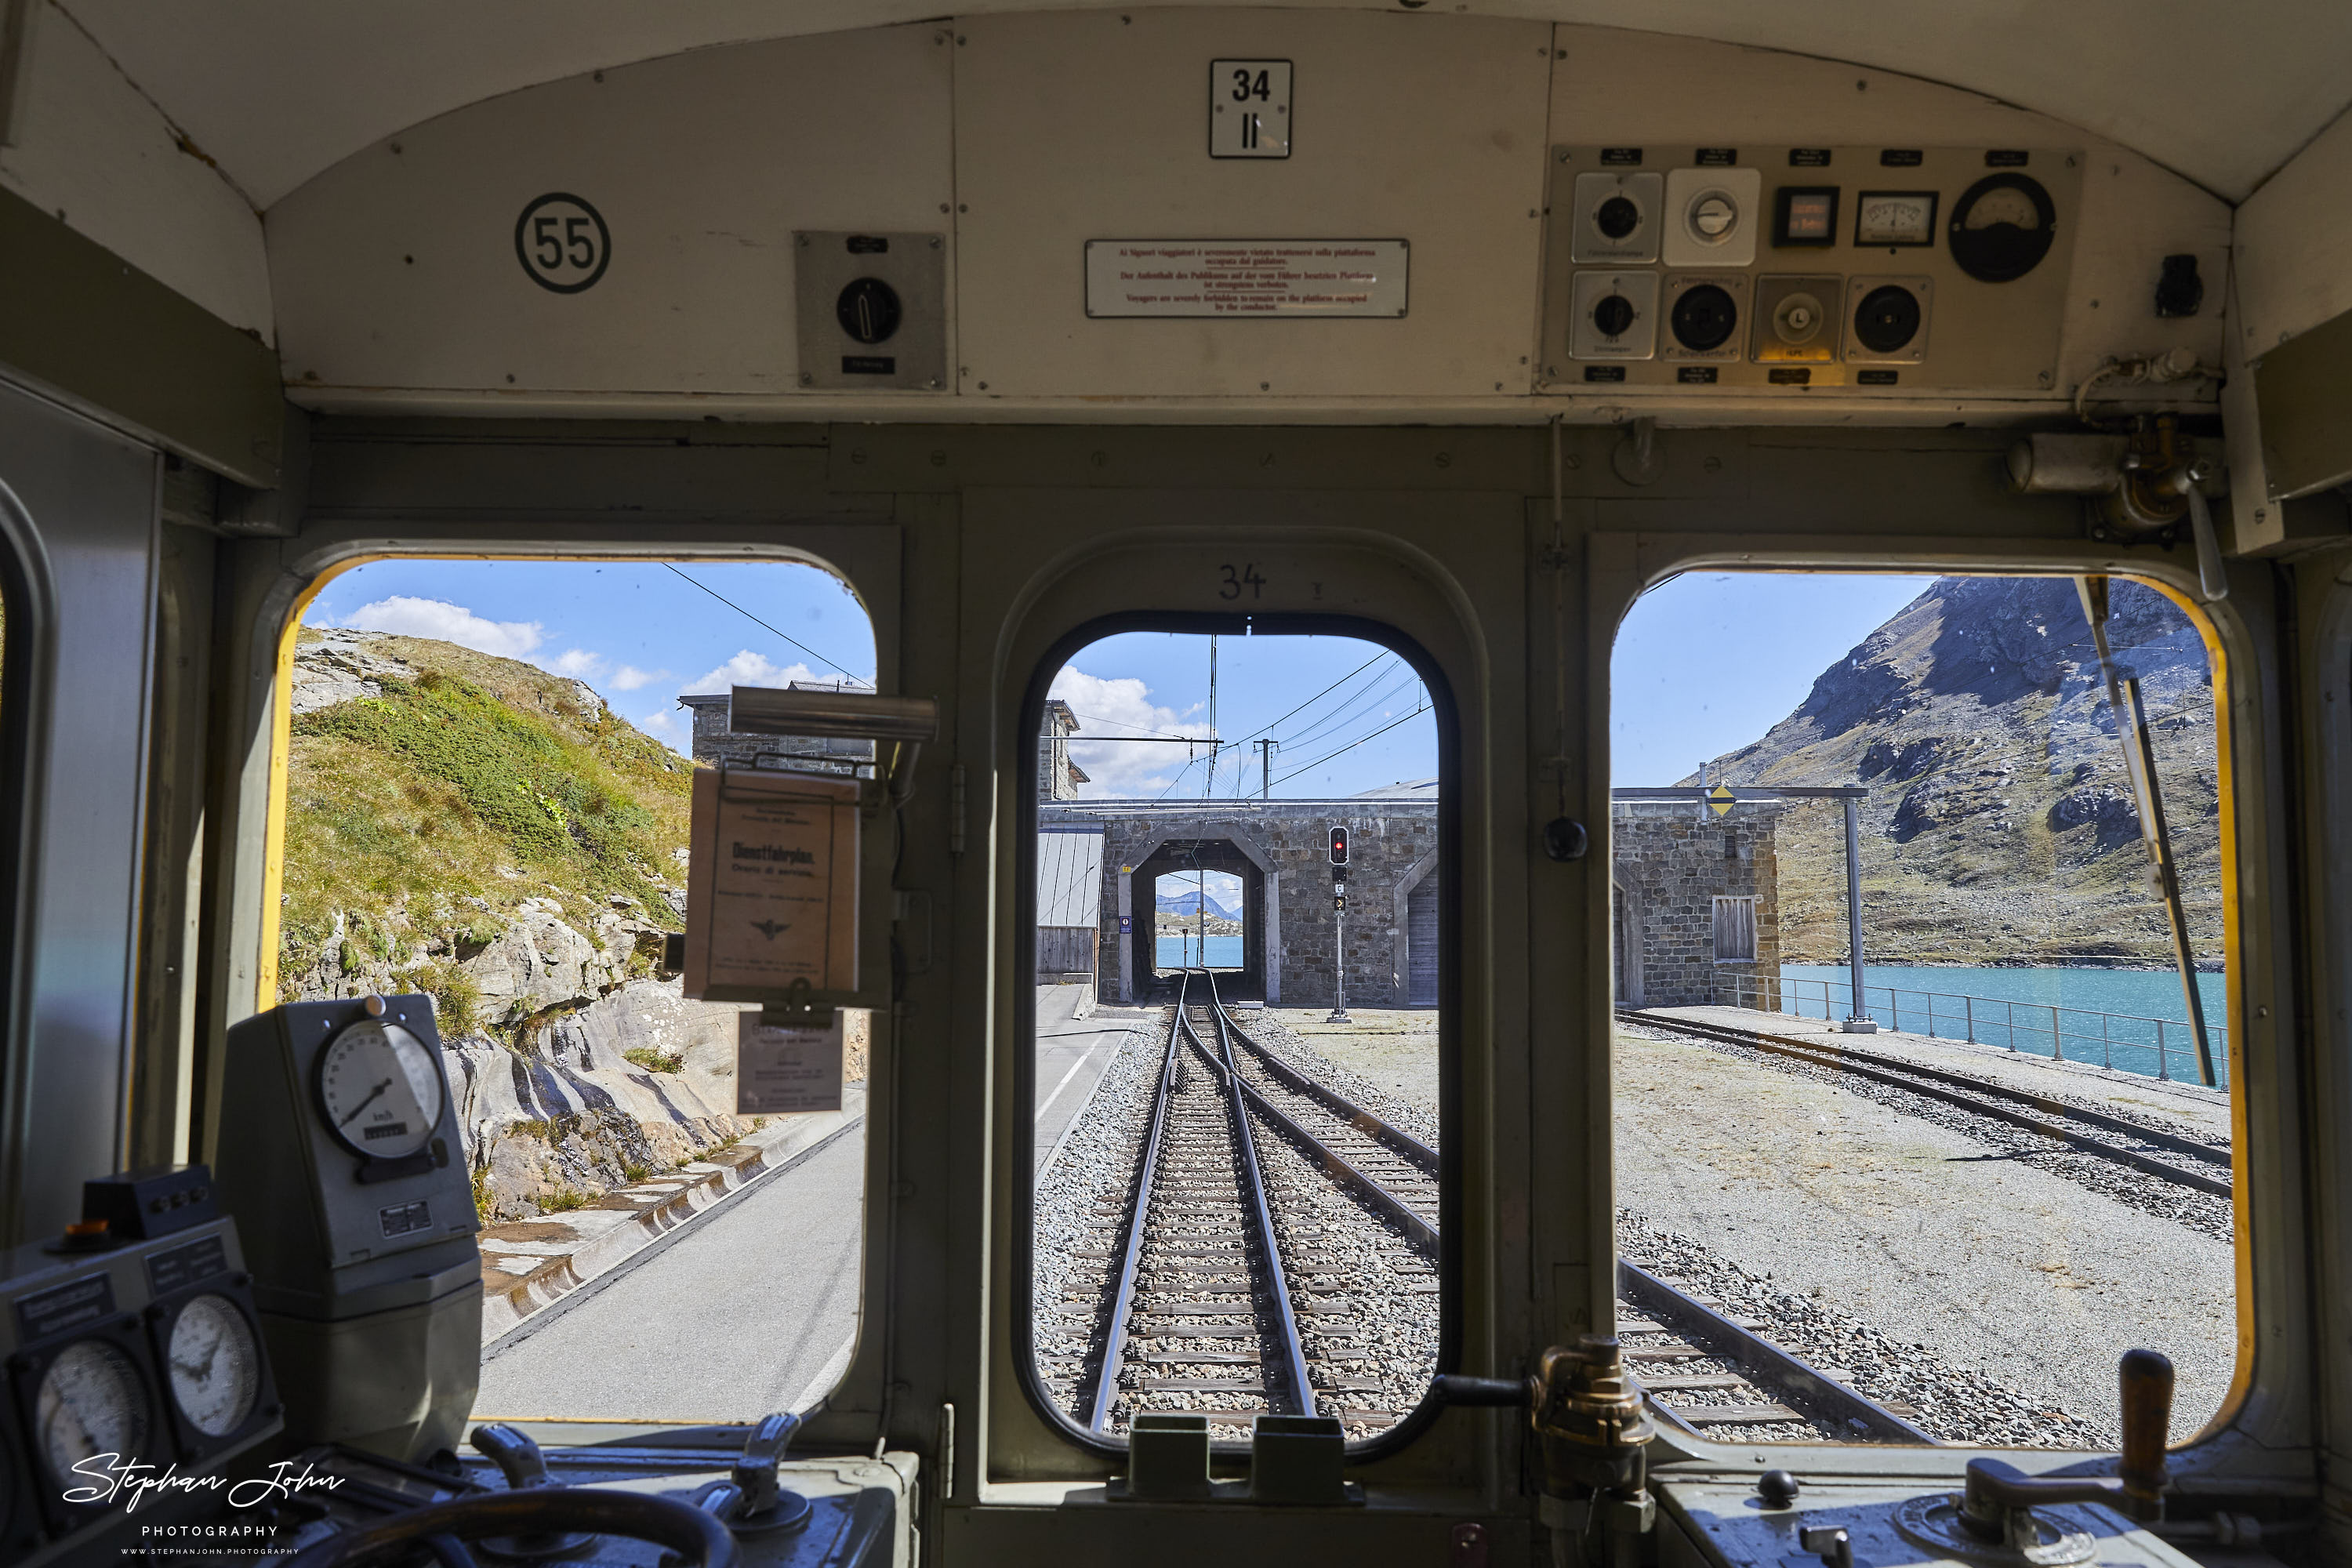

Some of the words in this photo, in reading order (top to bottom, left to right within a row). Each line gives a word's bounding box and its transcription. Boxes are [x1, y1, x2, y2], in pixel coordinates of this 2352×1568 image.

[1232, 69, 1270, 102] 34
[534, 217, 595, 270] 55
[1137, 271, 1174, 280] Aufenthalt
[1215, 303, 1224, 312] by
[1218, 564, 1267, 601] 34
